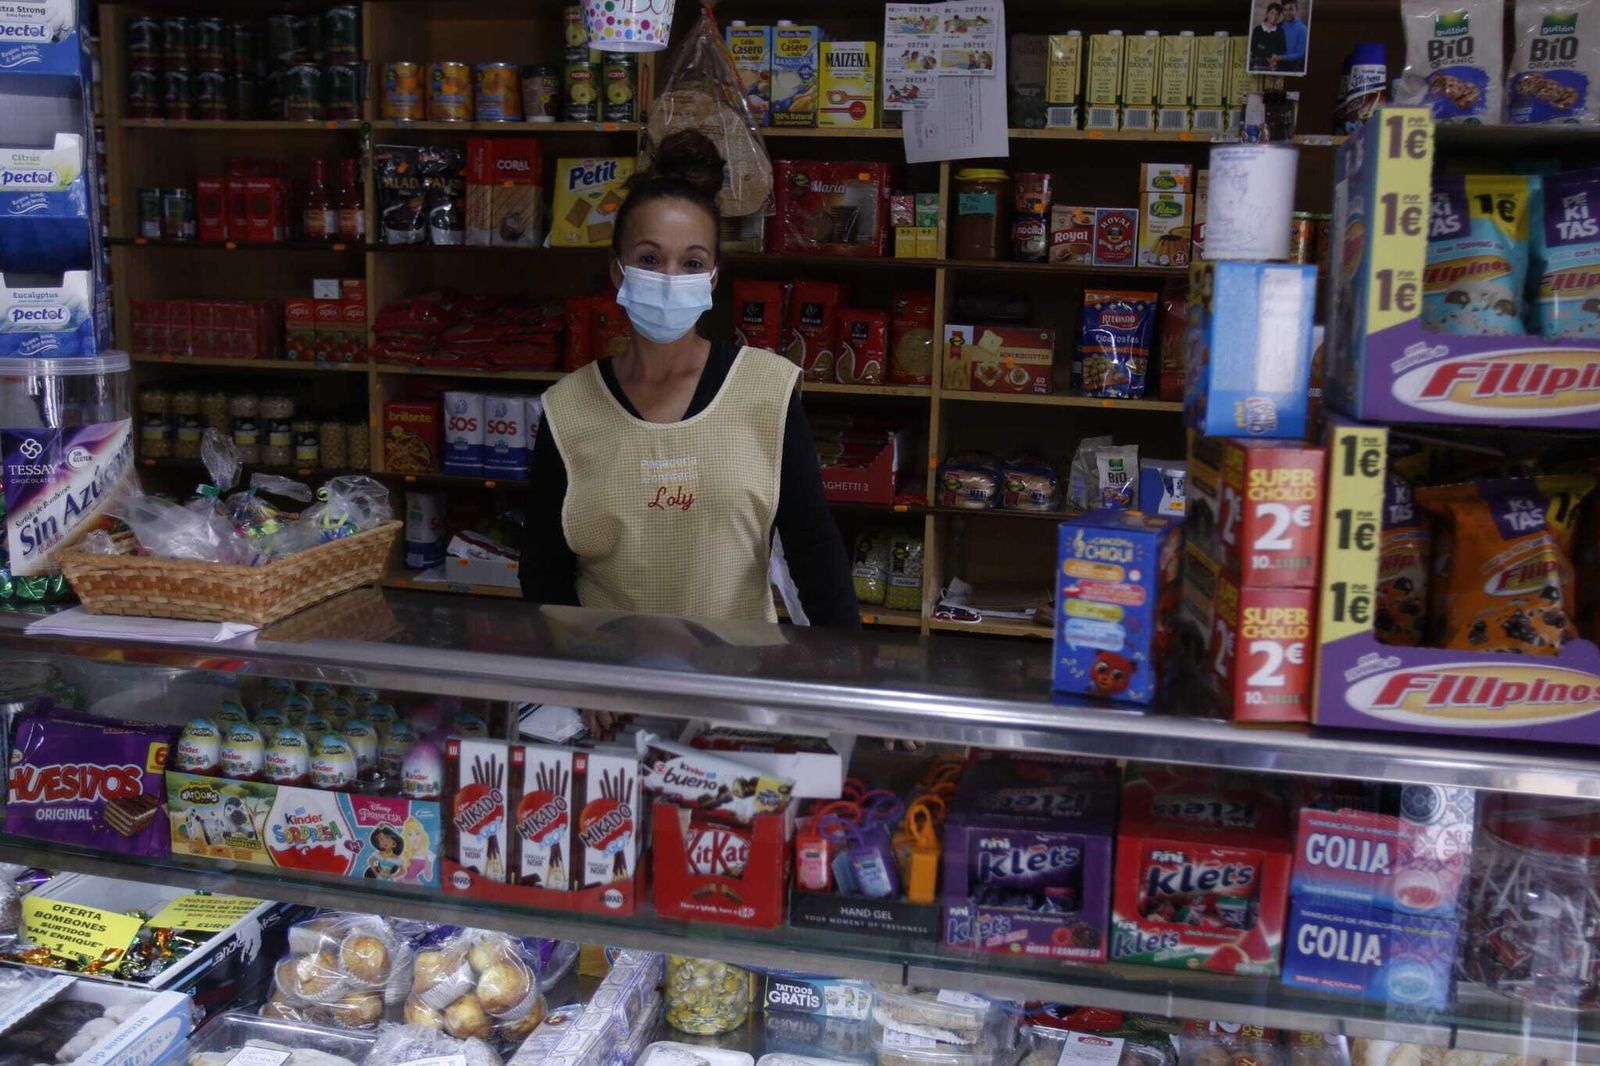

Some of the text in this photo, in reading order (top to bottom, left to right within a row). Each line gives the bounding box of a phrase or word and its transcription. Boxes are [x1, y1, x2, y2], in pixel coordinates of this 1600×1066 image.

[17, 6, 46, 15] Strong
[732, 45, 763, 54] Casero
[781, 43, 808, 52] Casero
[825, 53, 870, 67] MAIZENA
[1430, 57, 1474, 69] ORGANIC
[1528, 61, 1577, 69] ORGANIC
[12, 154, 41, 162] Citrus
[497, 159, 530, 171] CORAL
[2, 171, 54, 185] pectol
[569, 160, 617, 190] Petit
[1564, 206, 1589, 221] KI
[1101, 216, 1131, 229] ROYAL
[1556, 218, 1599, 240] TAS
[1054, 230, 1088, 243] Royal
[13, 309, 63, 322] pectol
[1419, 361, 1600, 398] Filipi
[388, 411, 431, 424] brillante
[449, 416, 477, 432] SOS
[487, 419, 517, 436] SOS
[8, 464, 57, 475] TESSAY
[1248, 468, 1316, 487] SUPER
[647, 486, 695, 511] Loly
[1247, 487, 1317, 500] CHOLLO
[1253, 502, 1312, 550] 2€
[1503, 508, 1545, 531] TAS
[19, 514, 57, 556] Sin
[1243, 607, 1309, 626] SUPER
[1242, 625, 1309, 639] CHOLLO
[1245, 640, 1305, 687] 2€
[663, 767, 718, 791] bueno
[35, 808, 93, 821] ORIGINAL
[453, 787, 504, 833] MIKADO
[516, 796, 568, 840] MIKADO
[272, 820, 343, 845] SORPRESA
[579, 803, 633, 848] MIKADO
[465, 851, 482, 860] NOIR
[688, 831, 750, 876] KitKat
[1305, 833, 1392, 875] GOLIA
[526, 859, 543, 868] NOIR
[590, 867, 608, 876] NOIR
[52, 904, 102, 920] OFERTA
[840, 905, 893, 920] HAND GEL
[34, 910, 108, 932] BOMBONES
[805, 914, 826, 922] YOUR
[829, 916, 864, 927] MOMENT
[881, 923, 928, 933] FRESHNESS
[41, 922, 91, 938] SURTIDOS
[53, 943, 64, 952] 1
[1297, 923, 1382, 966] GOLIA
[775, 982, 813, 995] TATTOOS
[769, 990, 820, 1008] GRATIS
